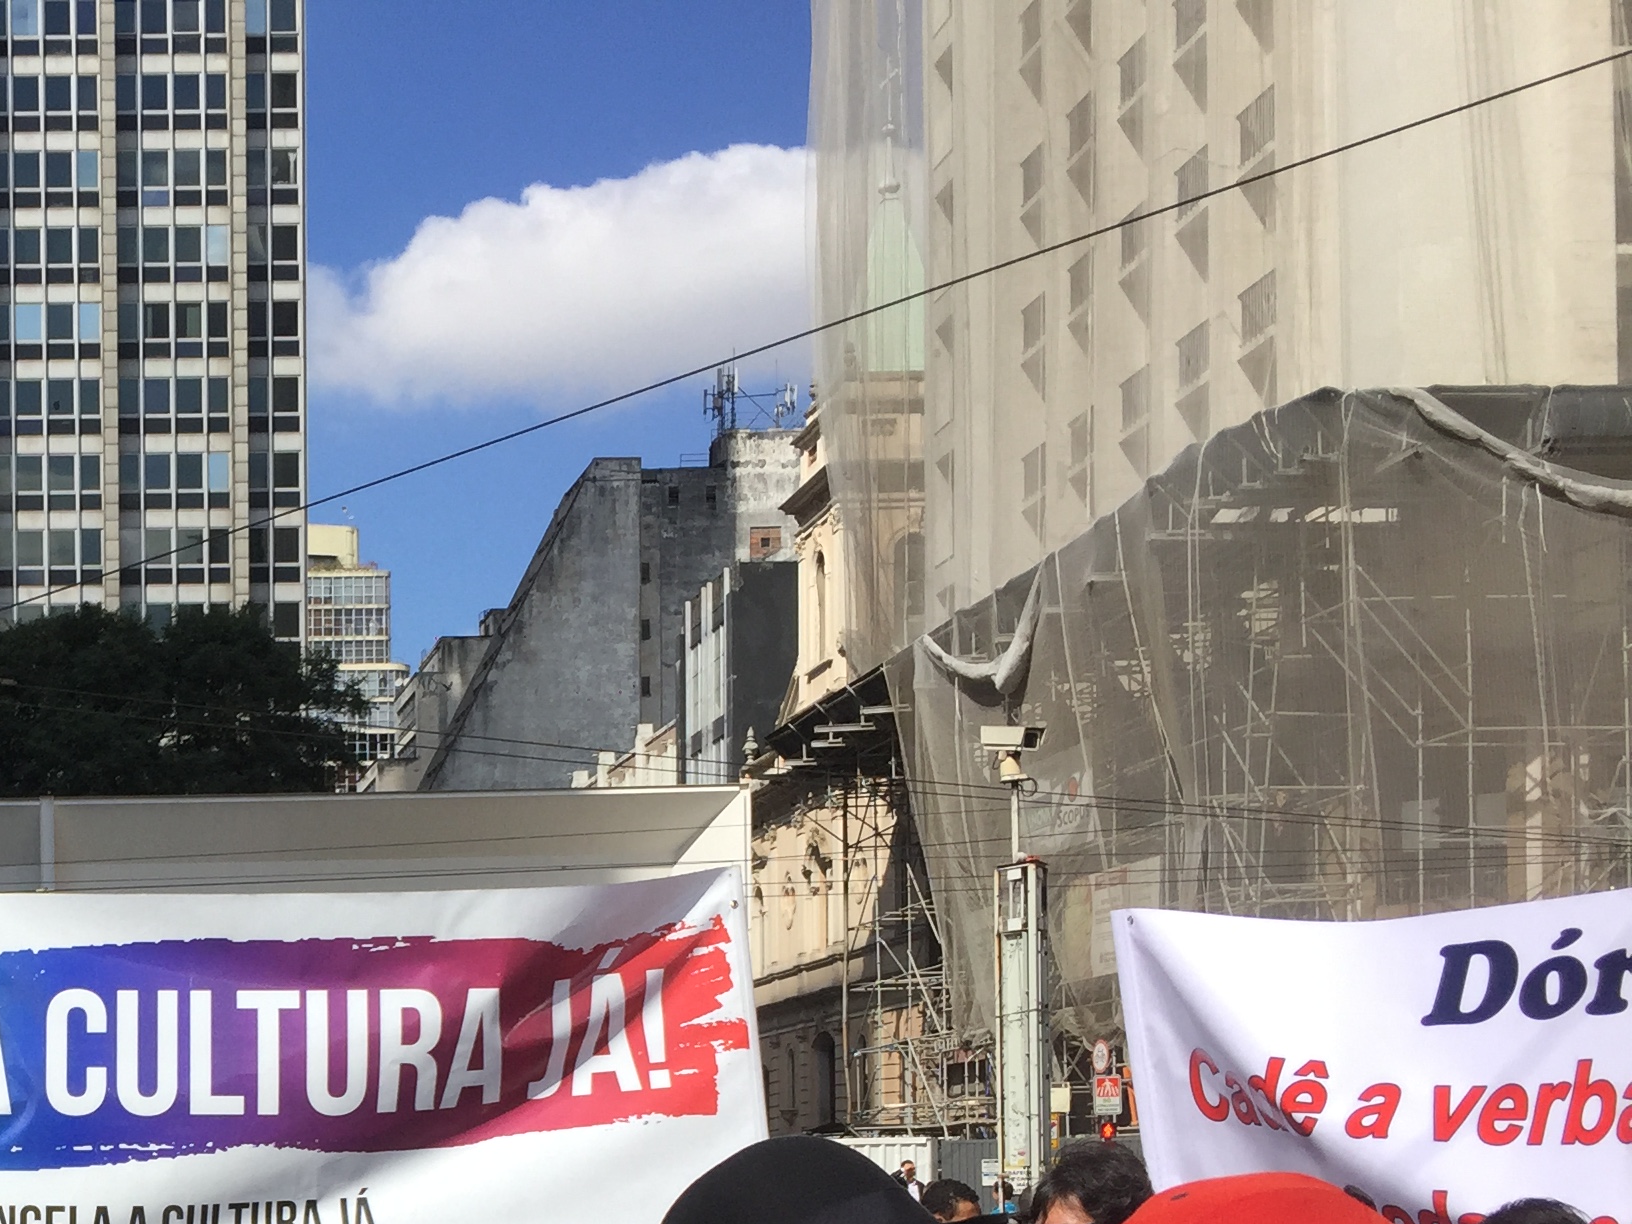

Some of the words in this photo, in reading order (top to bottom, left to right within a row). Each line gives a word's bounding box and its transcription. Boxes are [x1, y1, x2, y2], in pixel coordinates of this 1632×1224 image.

[44, 987, 502, 1118] CULTURA
[527, 946, 672, 1103] JÁ!
[1188, 1046, 1330, 1138] Cadê
[1344, 1082, 1403, 1140] a
